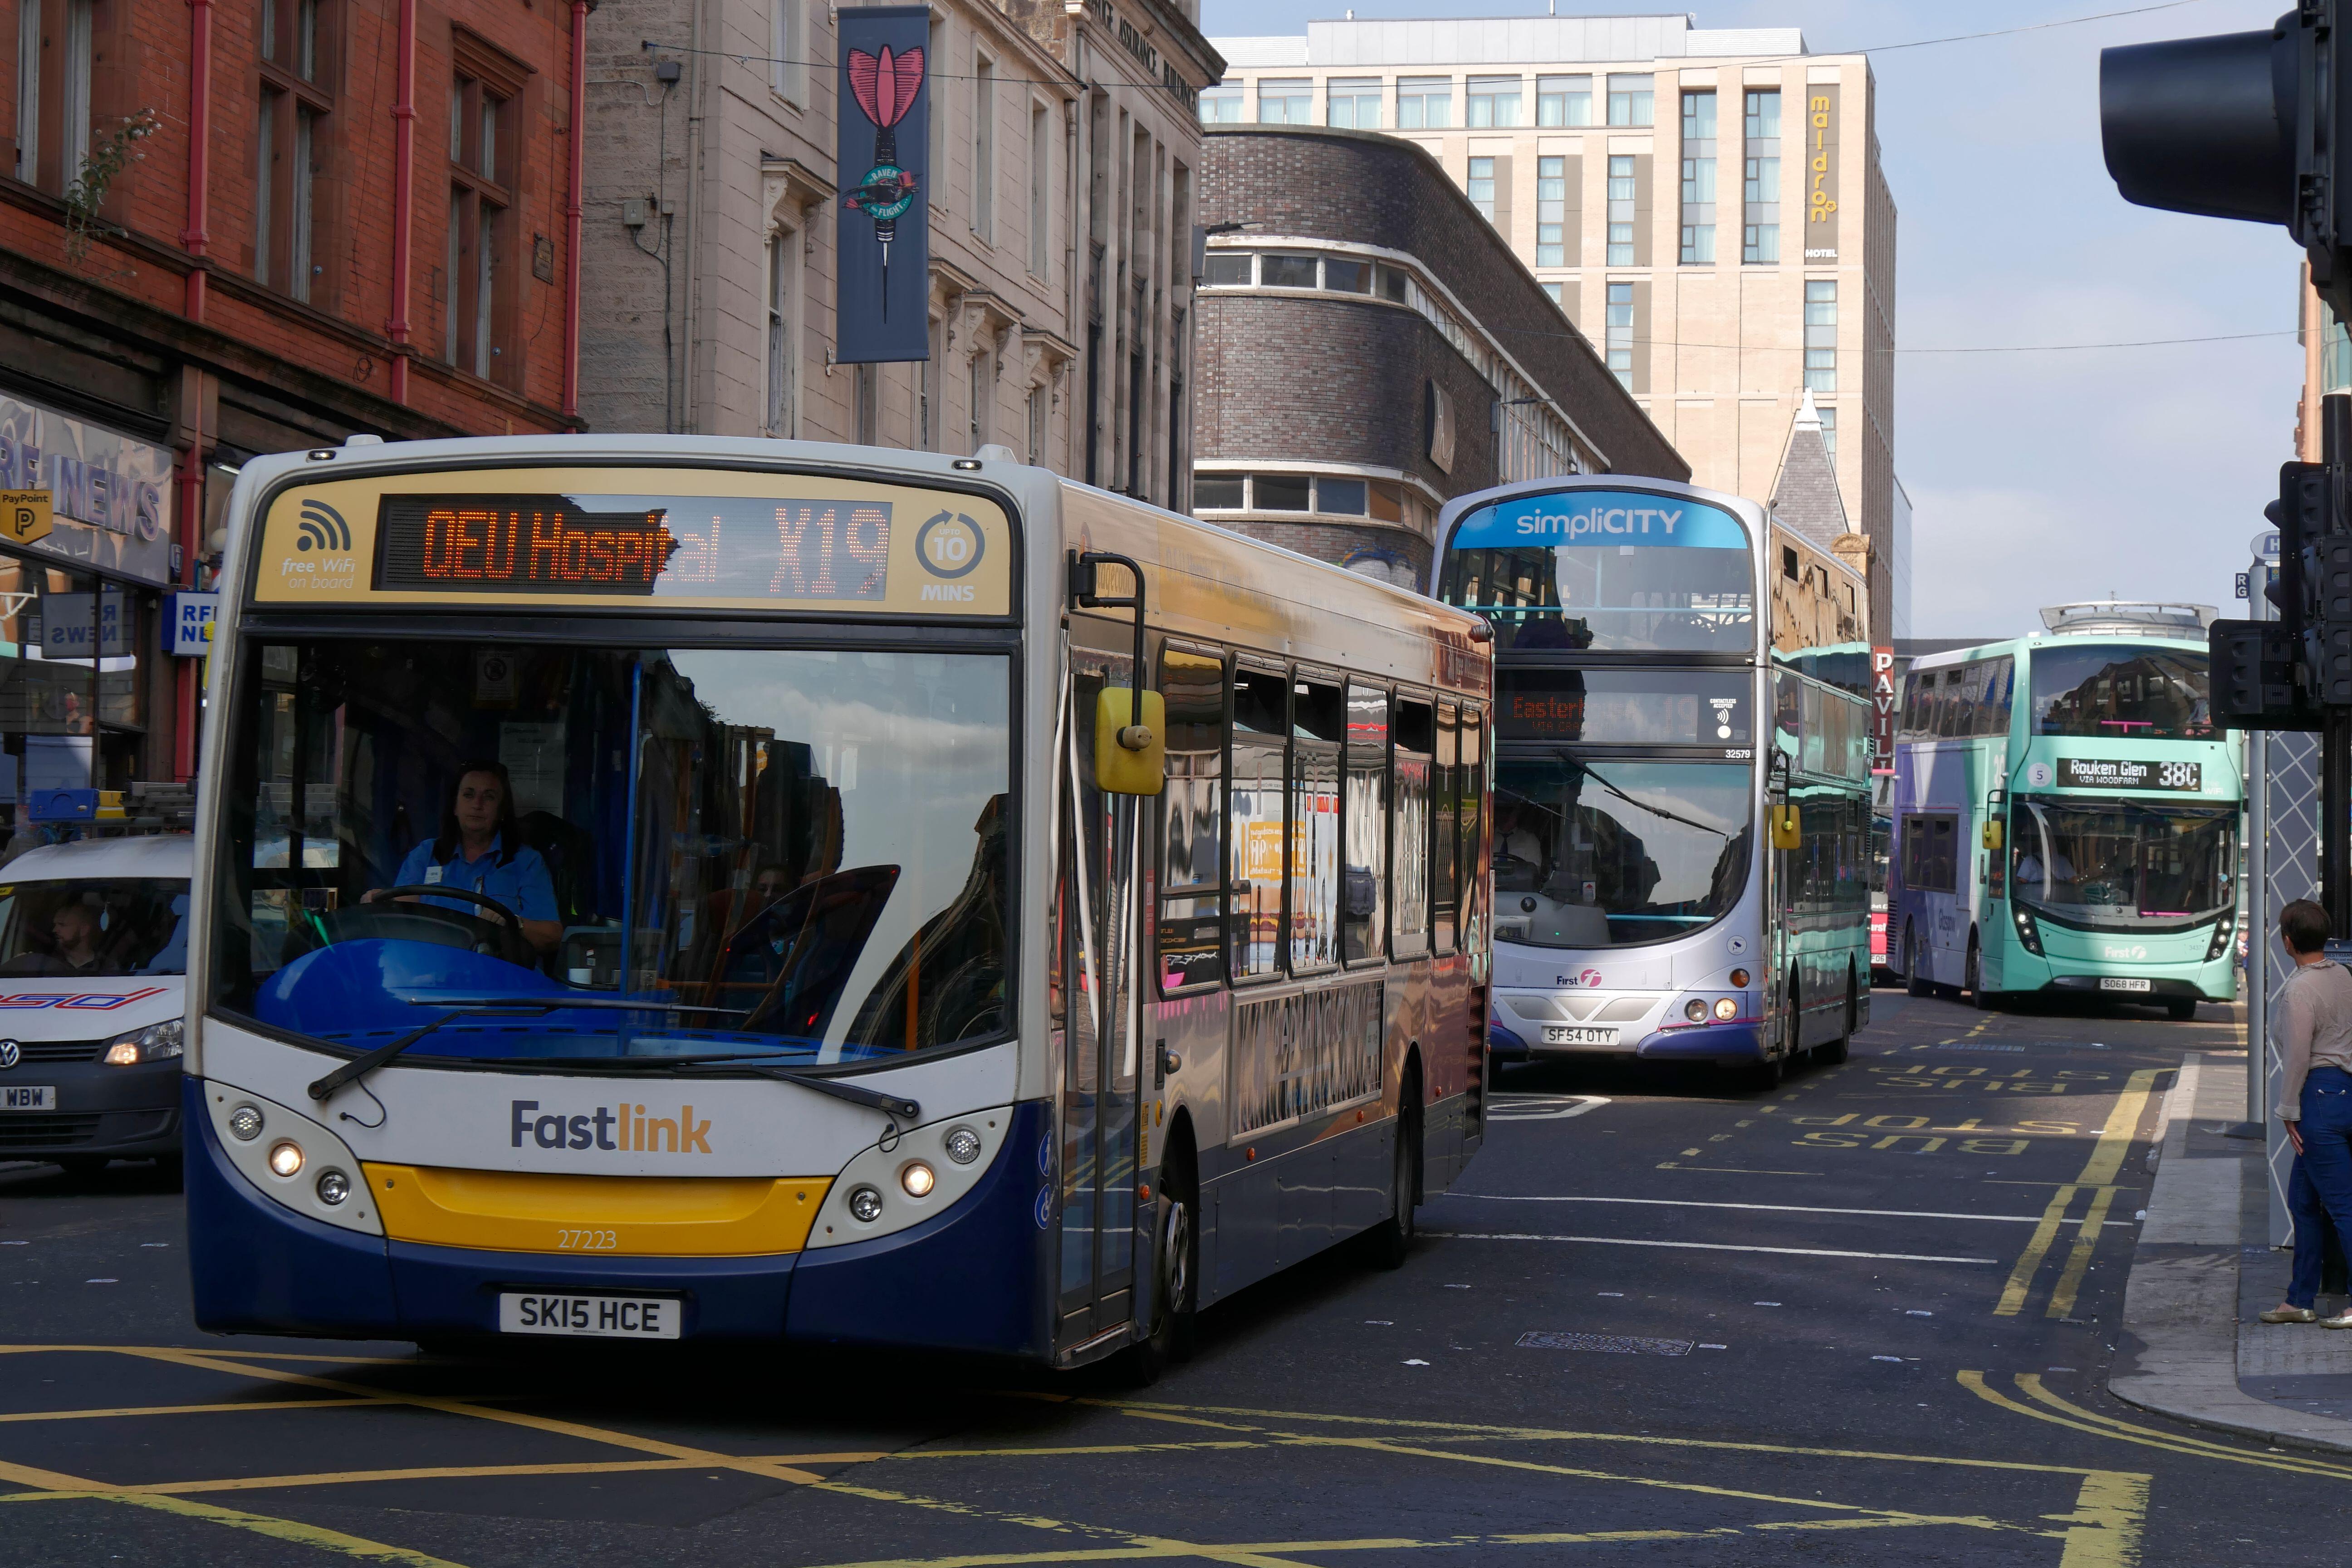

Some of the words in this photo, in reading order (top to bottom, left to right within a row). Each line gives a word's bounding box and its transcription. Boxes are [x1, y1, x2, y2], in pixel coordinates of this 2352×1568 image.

[1117, 16, 1156, 77] ASSURANCE
[1811, 96, 1830, 222] maldron
[871, 168, 897, 180] RAVEN
[1805, 249, 1838, 258] HOTEL
[3, 494, 49, 505] PayPoint
[54, 454, 159, 541] NEWS
[1516, 508, 1682, 540] simpliCITY
[529, 512, 720, 582] Hospital
[770, 508, 889, 594] X19
[933, 537, 967, 561] 10
[281, 558, 315, 576] free
[323, 558, 356, 572] WiFi
[289, 578, 306, 588] on
[311, 574, 355, 588] board
[921, 584, 975, 602] MINS
[1663, 696, 1697, 734] 19
[1725, 750, 1750, 759] 32579
[2036, 770, 2043, 780] 5
[2071, 759, 2117, 776] Rouken
[2120, 761, 2147, 777] Glen
[2159, 761, 2197, 787] 38C
[2096, 776, 2139, 785] WOODFARM
[2104, 946, 2130, 958] First
[1556, 975, 1578, 985] First
[2105, 980, 2127, 988] SO68
[2129, 980, 2146, 989] HFR
[1548, 1029, 1583, 1042] SF54
[1587, 1030, 1612, 1043] OTY
[6, 1088, 43, 1106] WBW
[511, 1100, 713, 1154] Fastlink
[1791, 1131, 2030, 1155] BUS
[558, 1229, 617, 1249] 27223
[520, 1297, 589, 1328] SK15
[599, 1300, 660, 1332] HCE
